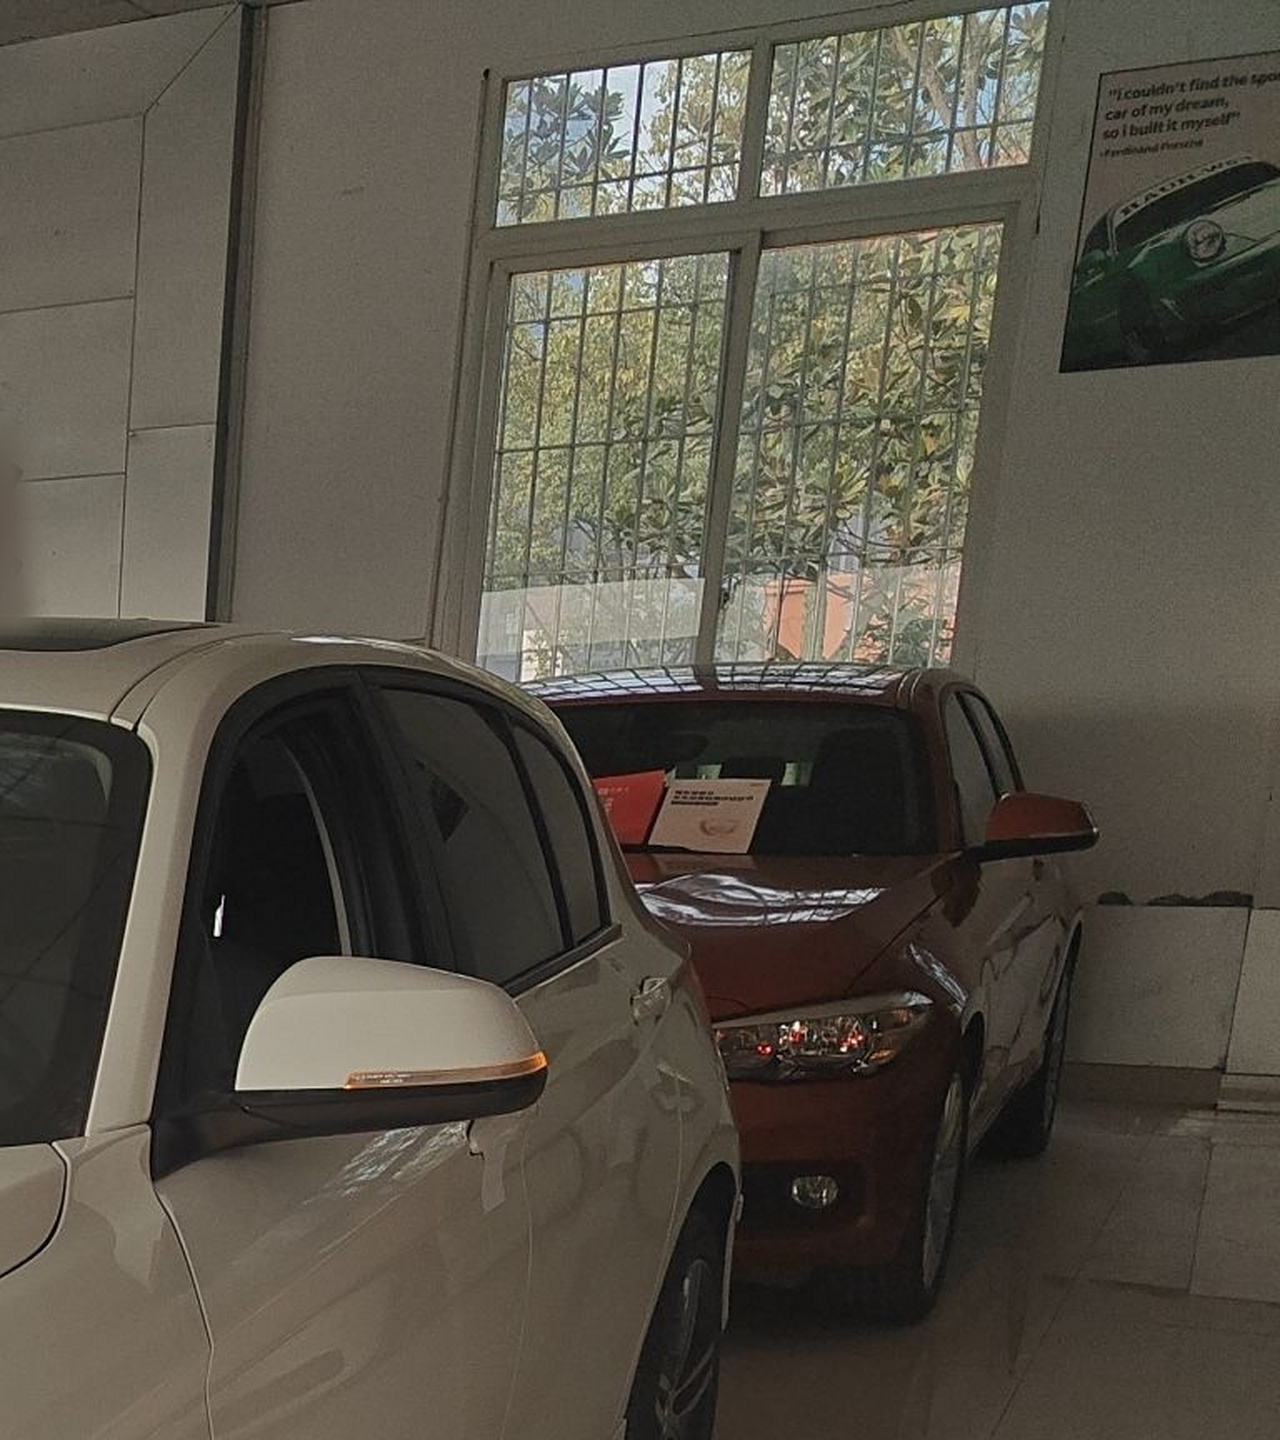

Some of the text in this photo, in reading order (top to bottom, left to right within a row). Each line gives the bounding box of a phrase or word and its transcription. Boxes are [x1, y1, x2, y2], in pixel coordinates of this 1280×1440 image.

[1124, 81, 1186, 100] couldn't
[1189, 76, 1220, 91] find
[1221, 74, 1248, 88] the
[1106, 109, 1128, 121] car
[1131, 103, 1149, 118] of
[1150, 103, 1173, 118] my
[1103, 128, 1120, 139] so
[1129, 120, 1164, 137] built
[1166, 118, 1178, 132] it
